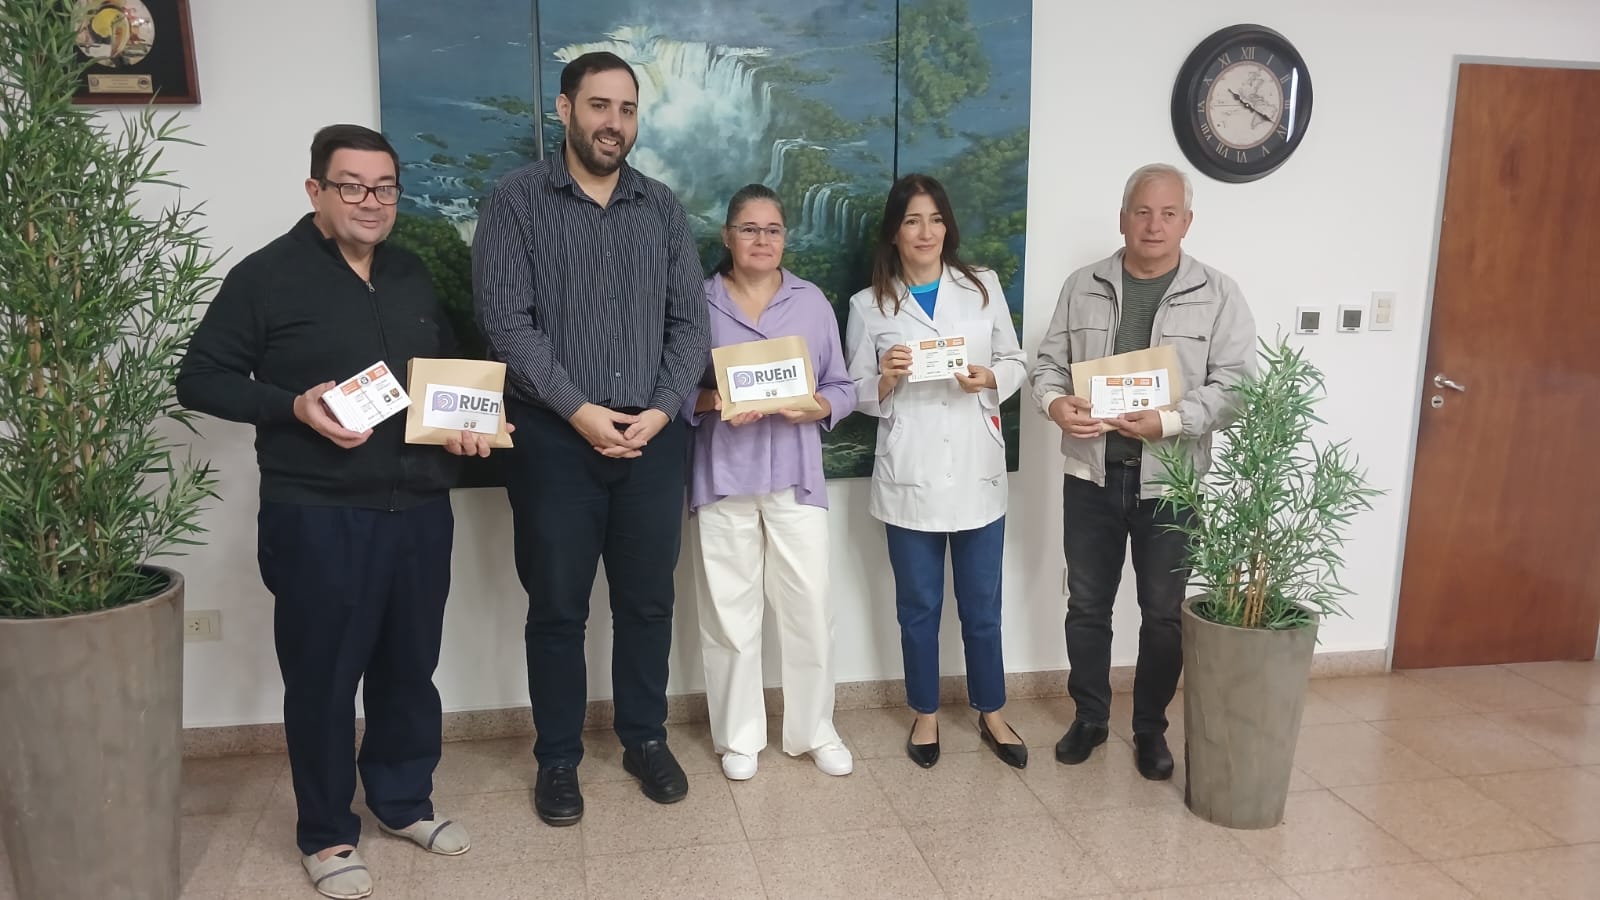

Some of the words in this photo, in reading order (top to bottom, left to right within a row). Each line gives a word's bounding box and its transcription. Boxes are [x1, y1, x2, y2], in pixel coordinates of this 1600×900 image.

[1240, 47, 1256, 60] XII
[1218, 52, 1232, 68] XI
[1236, 151, 1248, 163] VI
[1262, 145, 1271, 157] V
